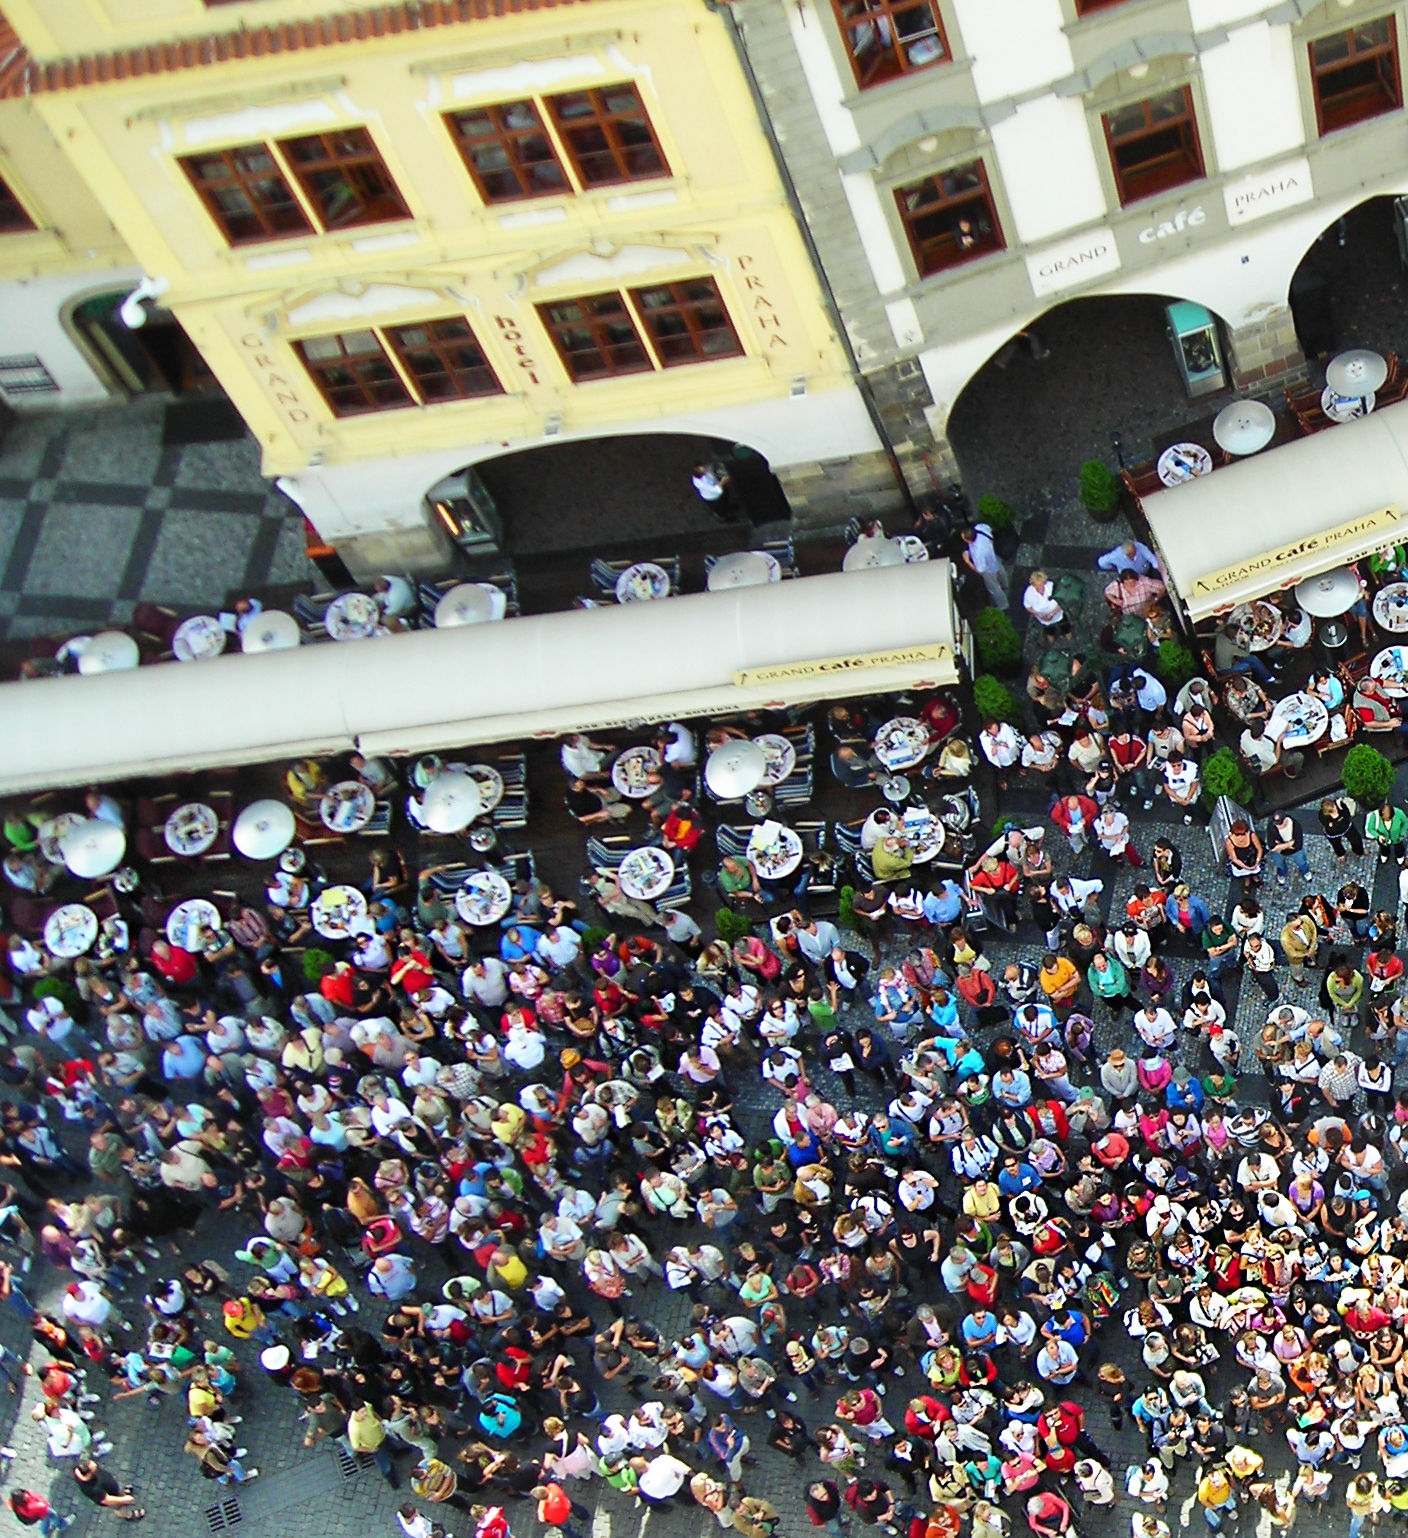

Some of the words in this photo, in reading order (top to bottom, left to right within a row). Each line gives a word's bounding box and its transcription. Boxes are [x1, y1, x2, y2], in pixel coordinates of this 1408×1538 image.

[1038, 245, 1108, 278] GRAND
[1137, 206, 1206, 244] café
[1234, 177, 1299, 208] PRAHA
[736, 255, 789, 349] PRAHA
[241, 332, 309, 423] GRAND
[494, 314, 540, 385] hotel
[1215, 558, 1272, 584] GRAND
[1275, 538, 1319, 561] café
[1324, 519, 1377, 544] PRAHA
[756, 666, 816, 681] GRAND
[818, 658, 865, 672] café
[870, 650, 926, 666] PRAHA
